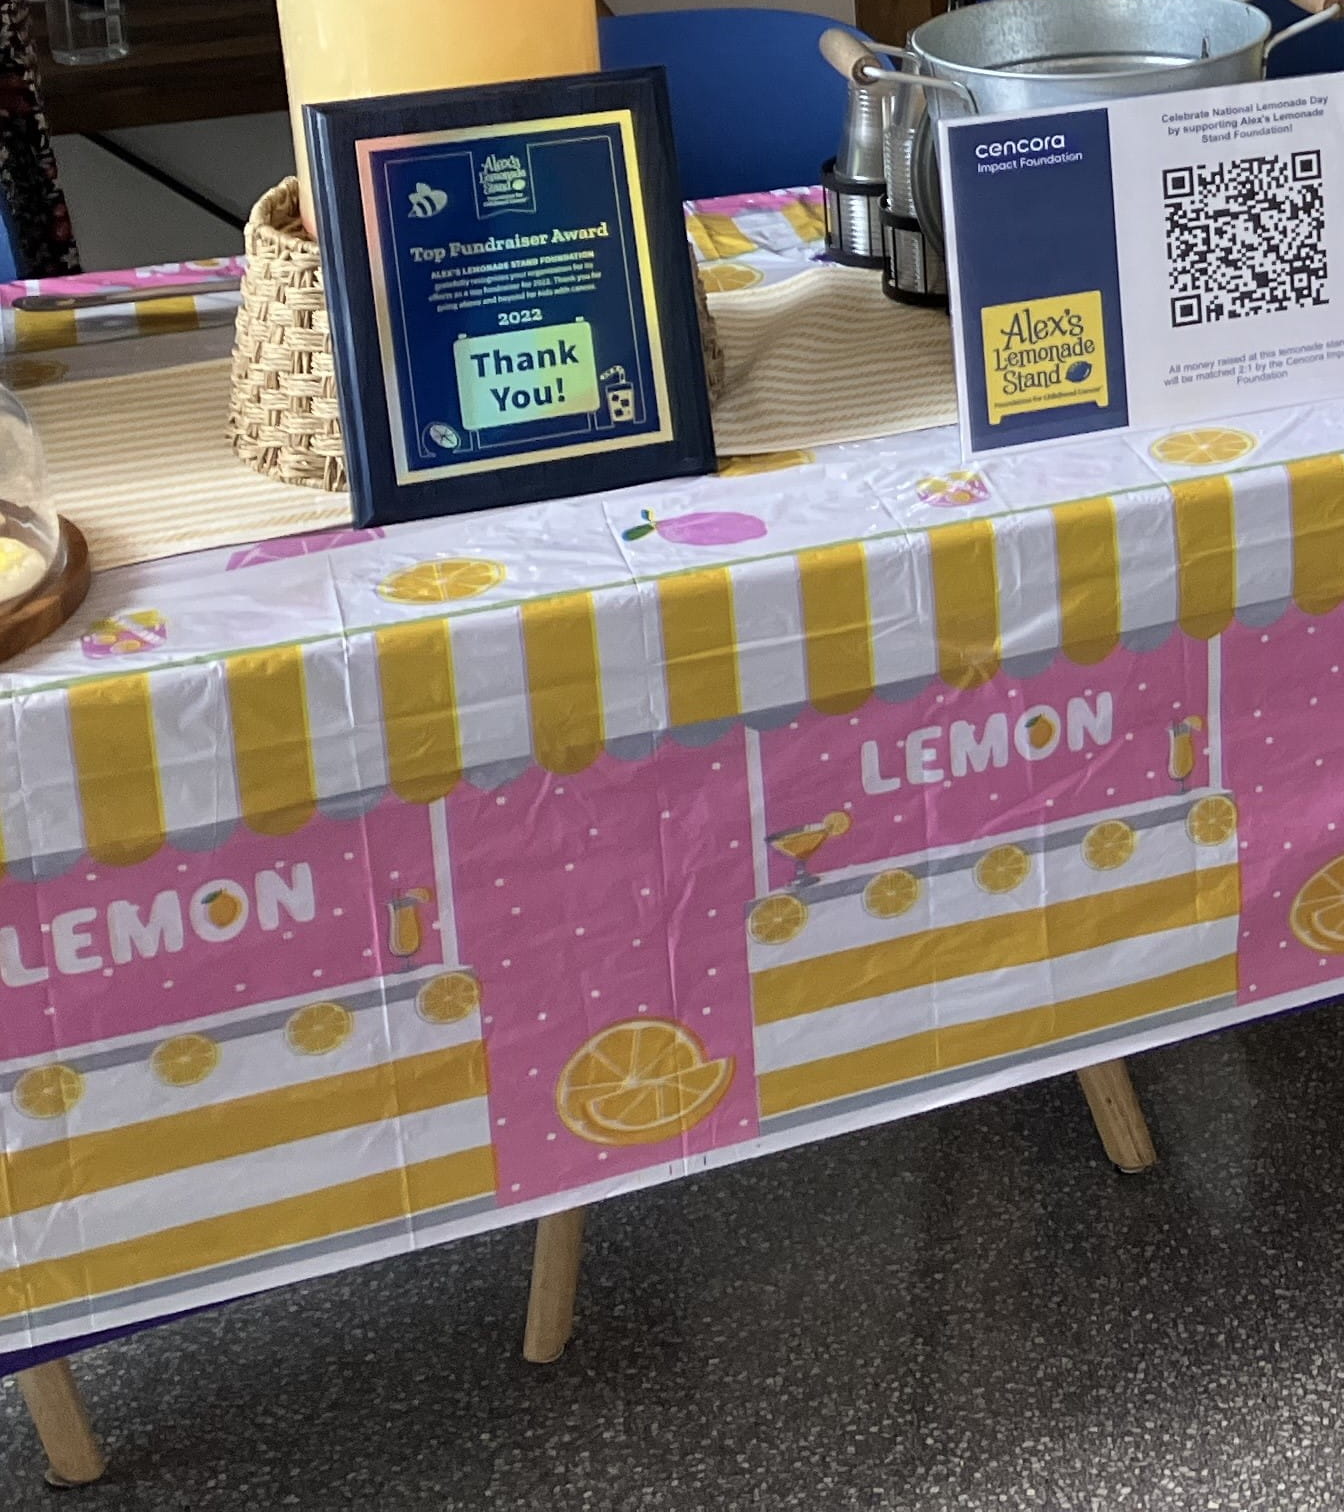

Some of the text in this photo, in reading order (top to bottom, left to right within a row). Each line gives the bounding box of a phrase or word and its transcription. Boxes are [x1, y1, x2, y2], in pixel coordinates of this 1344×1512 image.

[1161, 94, 1328, 123] Celebrate National Lemonade Day
[1167, 106, 1323, 136] by supporting Alex's Lemonade
[976, 134, 1064, 158] cencora
[1201, 123, 1292, 143] Stand Foundation!
[978, 152, 1082, 174] Impact Foundation
[410, 222, 609, 262] Top Fundraiser Award
[498, 308, 543, 326] 2022
[1000, 308, 1084, 351] Alex's
[470, 340, 580, 378] Thank
[994, 337, 1096, 371] Lemonade
[1003, 363, 1062, 395] Stand
[1236, 369, 1288, 384] Foundation
[490, 378, 566, 412] You!
[860, 691, 1114, 796] LEMON
[0, 862, 316, 987] LEMON
